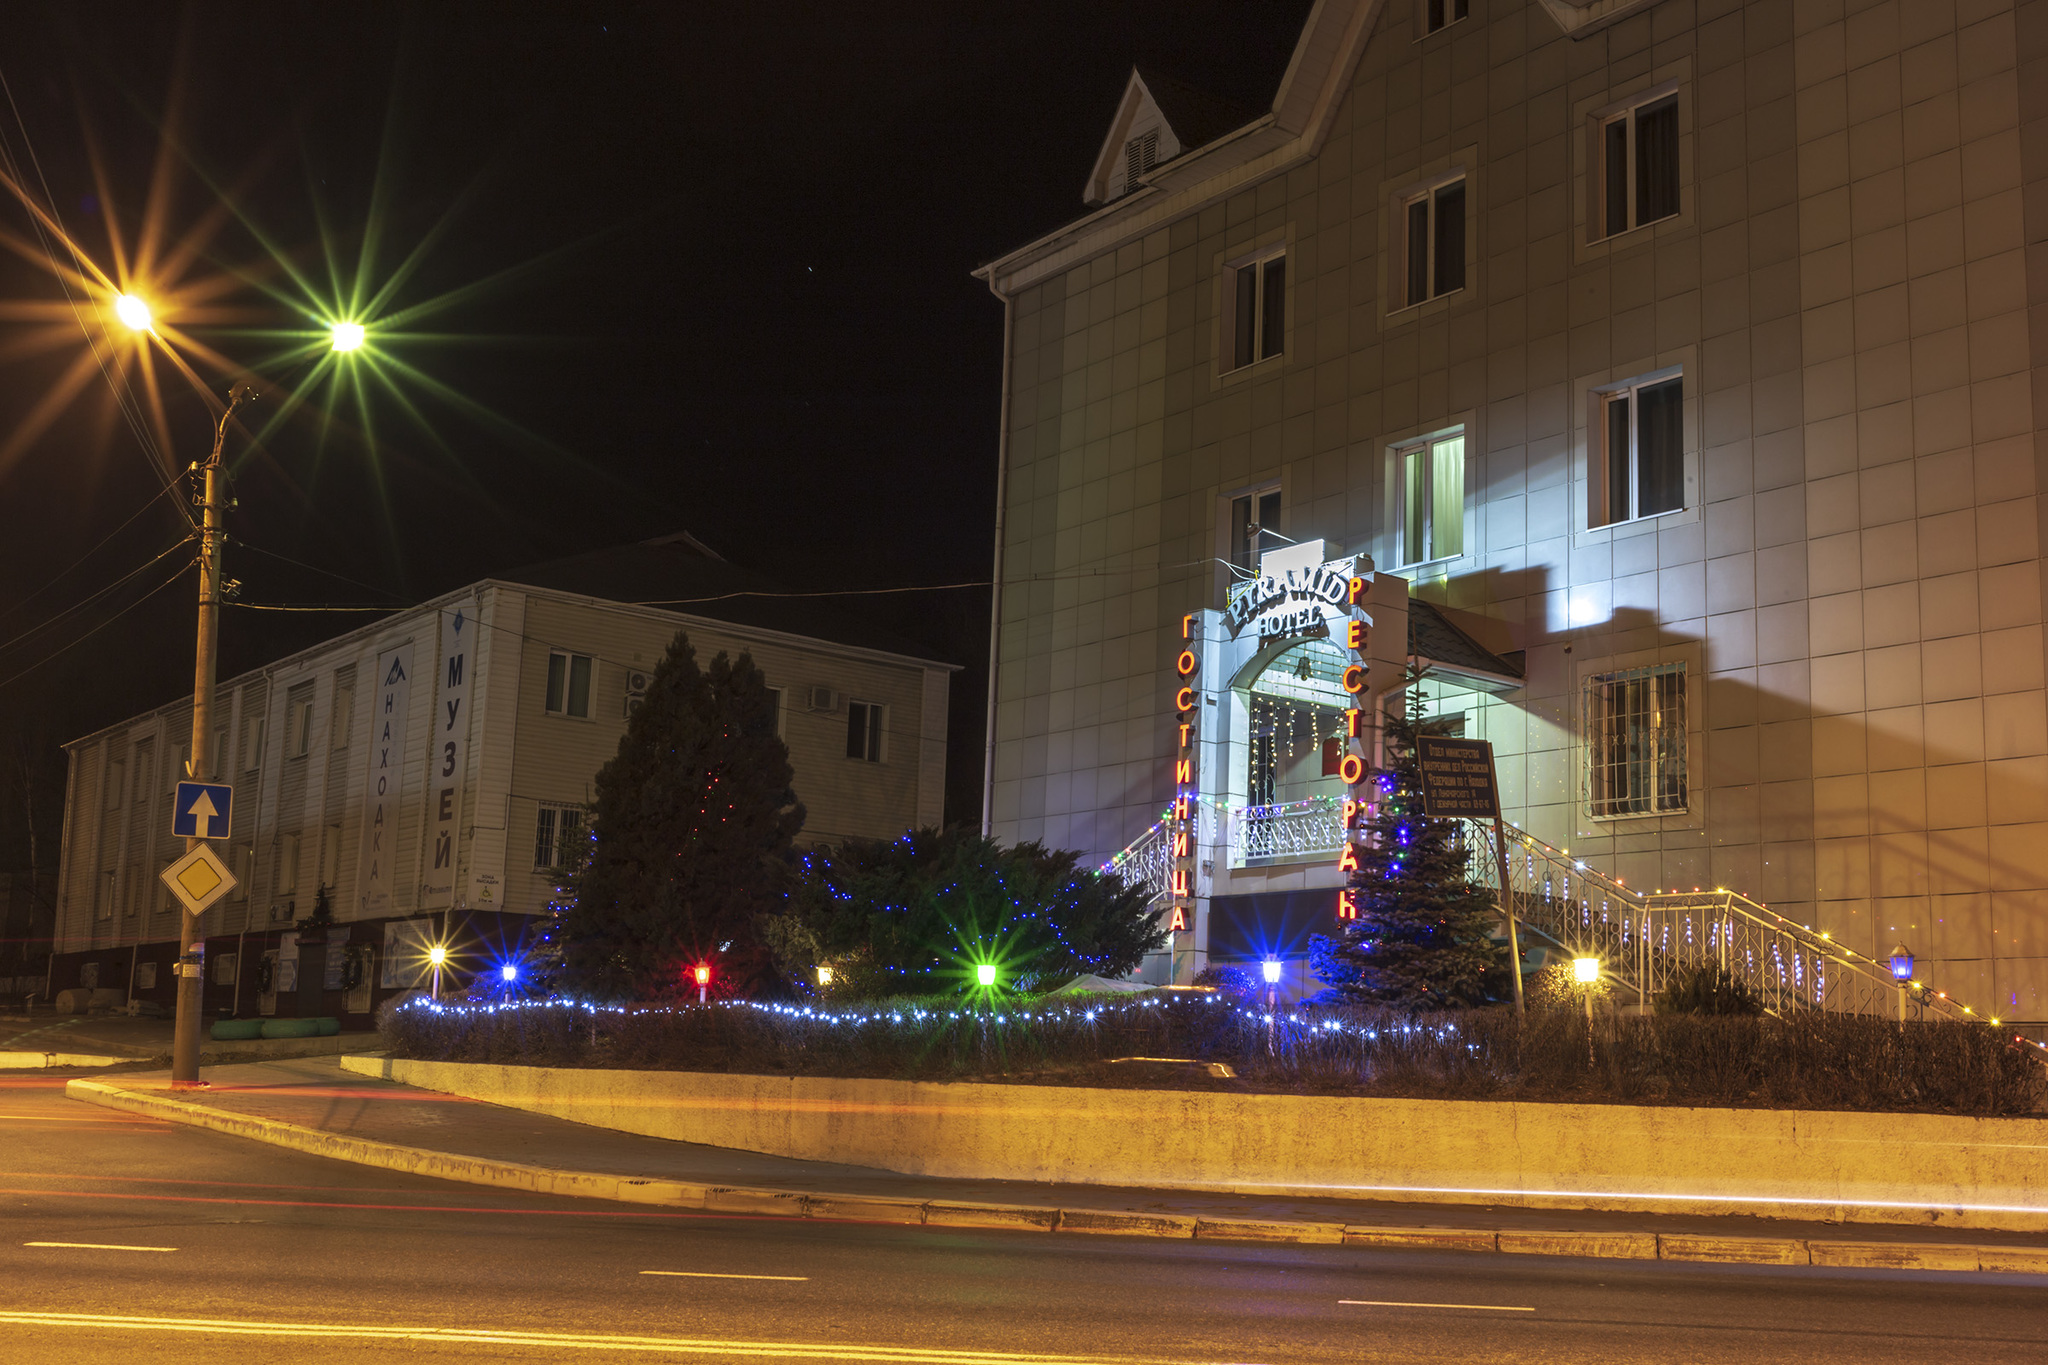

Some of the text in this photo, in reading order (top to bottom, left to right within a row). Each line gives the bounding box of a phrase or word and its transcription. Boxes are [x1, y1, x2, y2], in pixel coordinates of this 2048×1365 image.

[1227, 566, 1348, 627] PYRAMID
[1258, 605, 1322, 637] HOTEL
[370, 692, 394, 881] НАХОДКА
[434, 653, 464, 870] МУЗЕЙ
[1170, 614, 1198, 931] ГОСТИНИЦА
